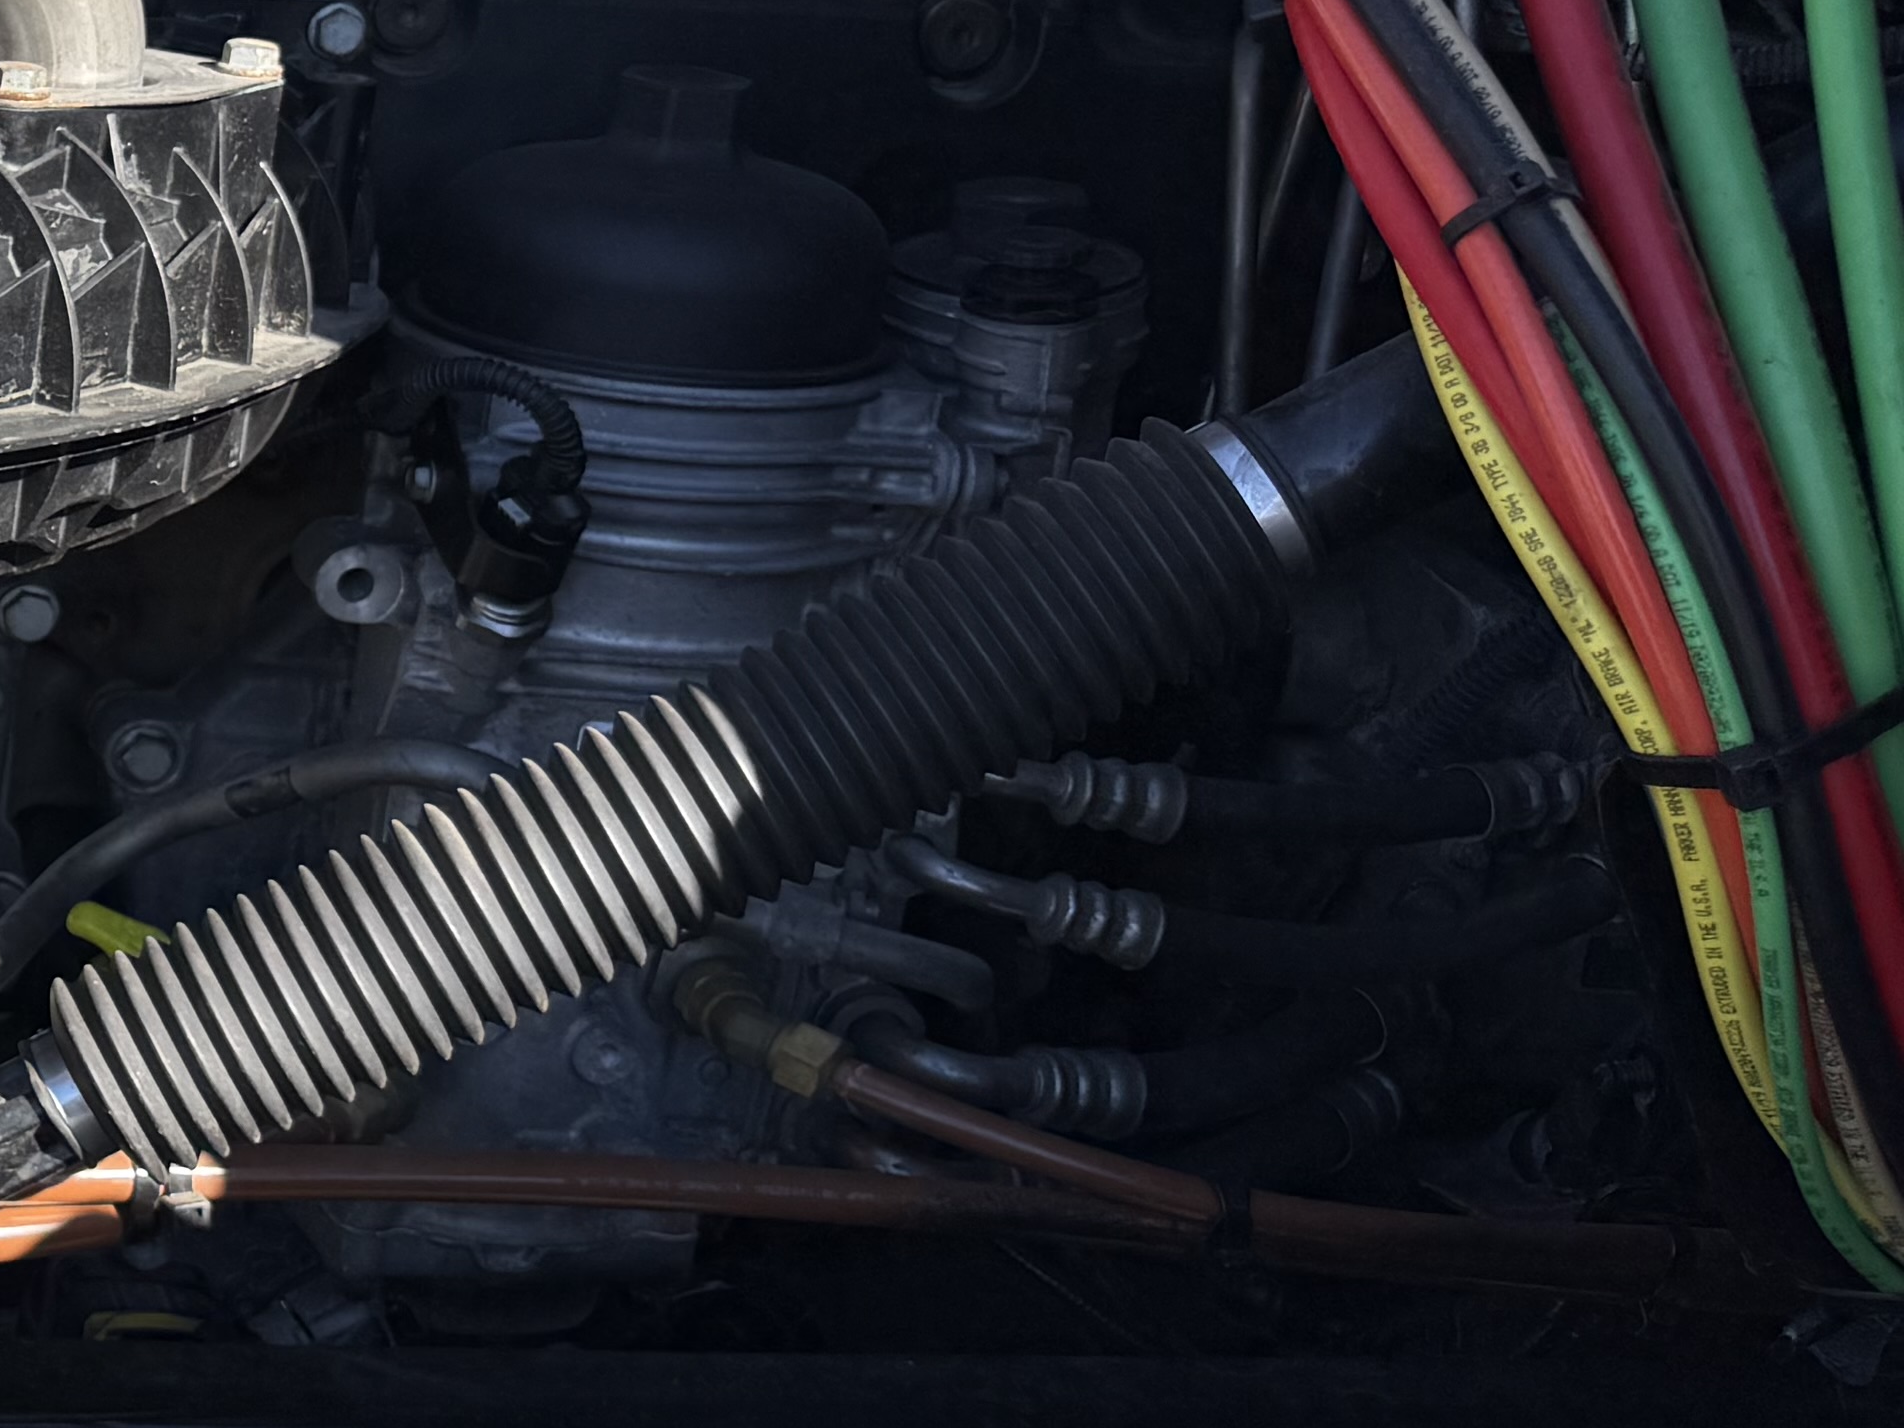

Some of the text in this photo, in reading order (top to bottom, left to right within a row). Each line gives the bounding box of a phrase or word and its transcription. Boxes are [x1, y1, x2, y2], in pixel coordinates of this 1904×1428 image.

[1434, 354, 1455, 375] DOT
[1451, 393, 1468, 408] OD
[1459, 412, 1480, 435] 3/8
[1471, 439, 1490, 455] 3B
[1481, 459, 1509, 491] TYPE
[1500, 493, 1527, 523] J844
[1520, 528, 1544, 552] SAE
[1537, 554, 1577, 610] 1220-6B
[1592, 647, 1624, 688] BRAKE
[1615, 689, 1640, 715] AIR
[1674, 822, 1700, 862] PARKER
[1694, 878, 1716, 917] U.S.A.
[1700, 919, 1717, 943] THE
[1706, 946, 1724, 960] IN
[1709, 966, 1739, 1015] EXTRUDED
